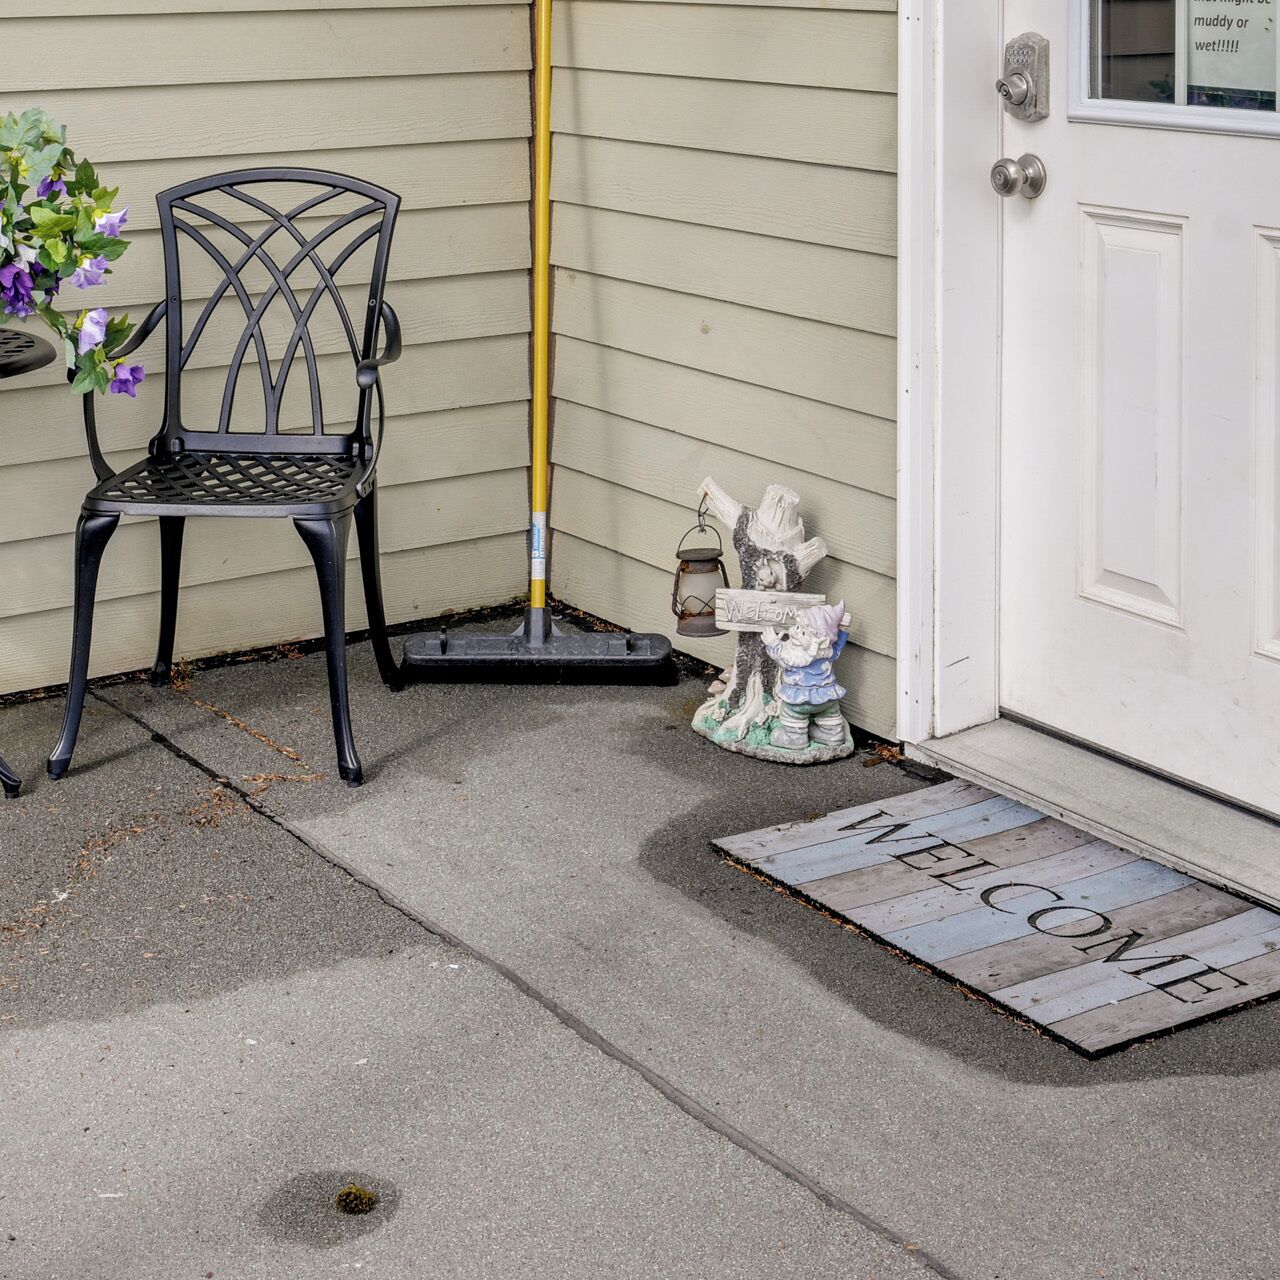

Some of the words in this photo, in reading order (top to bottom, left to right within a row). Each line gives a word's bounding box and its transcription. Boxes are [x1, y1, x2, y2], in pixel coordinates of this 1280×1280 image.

[1193, 14, 1233, 31] muddy
[1236, 18, 1249, 29] or
[837, 809, 1249, 1004] WELCOME
